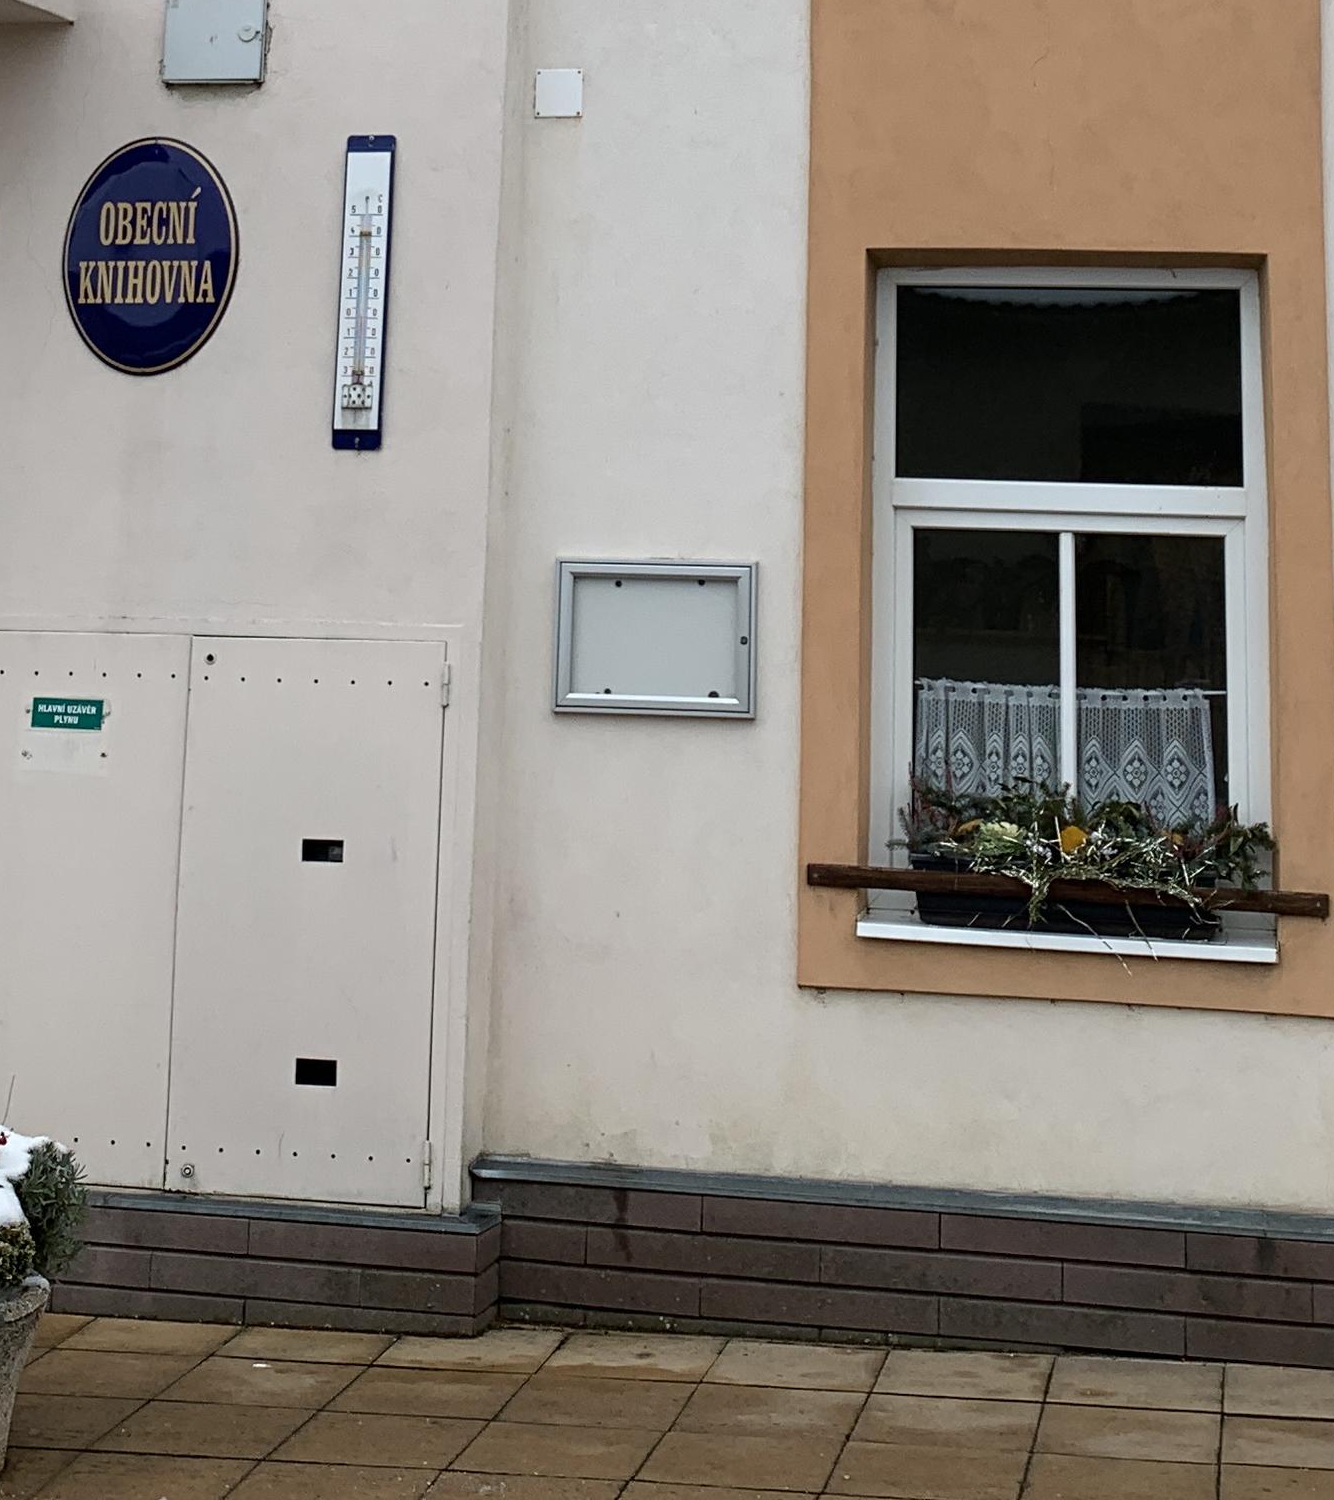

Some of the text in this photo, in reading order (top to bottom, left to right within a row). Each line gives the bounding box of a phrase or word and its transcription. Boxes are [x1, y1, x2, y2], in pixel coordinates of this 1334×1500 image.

[99, 187, 202, 246] OBECNÍ
[77, 260, 216, 305] KNIHOVNA
[38, 703, 97, 714] HLAVNÍ UZÁVĚR
[54, 715, 79, 724] PLYNU
